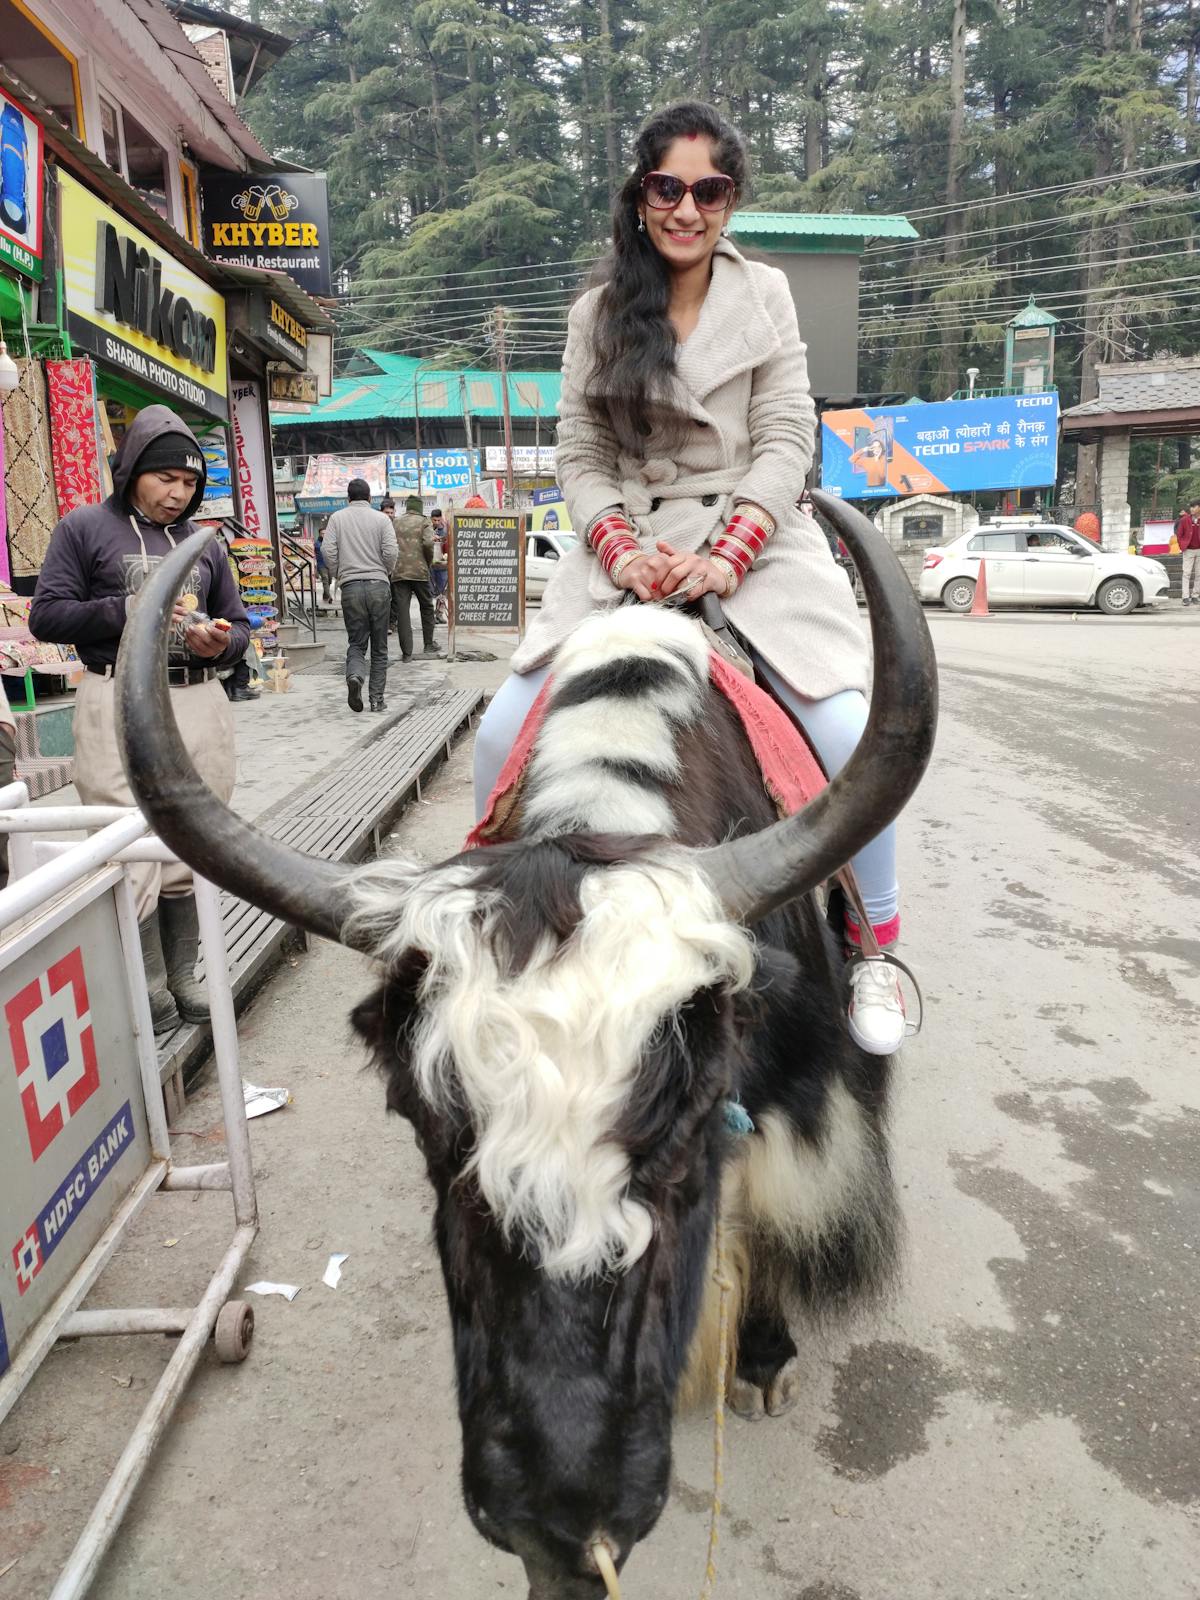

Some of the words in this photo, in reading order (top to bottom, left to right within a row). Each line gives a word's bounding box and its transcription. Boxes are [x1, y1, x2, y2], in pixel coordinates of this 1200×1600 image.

[212, 223, 319, 247] KHYBER
[257, 255, 320, 269] Restaurant
[95, 220, 217, 375] Nikon
[271, 300, 307, 349] KHYBER
[106, 338, 148, 377] SHARMA
[149, 366, 178, 391] PHOTO
[178, 377, 206, 406] STUDIO
[1016, 396, 1053, 408] TECNO
[956, 423, 992, 439] त्योहारों
[996, 421, 1011, 435] की
[913, 442, 960, 457] TECNO
[964, 439, 1011, 453] SPARK
[1014, 434, 1026, 448] के
[1031, 434, 1049, 447] संग
[233, 403, 261, 535] STAURANT
[457, 518, 483, 529] TODAY
[485, 519, 516, 529] SPECIAL
[457, 531, 477, 539] FISH
[479, 531, 506, 539] CURRY
[457, 540, 474, 548] DAL
[477, 540, 508, 548] YELLOW
[457, 549, 476, 557] VEG.
[469, 585, 489, 593] STEAK
[489, 585, 517, 593] SIZZLER
[477, 594, 500, 602] PIZZA
[459, 603, 490, 611] CHICKEN
[490, 603, 513, 611] PIZZA
[459, 612, 486, 621] CHEESE
[488, 612, 512, 621] PIZZA
[43, 1171, 86, 1244] HDFC
[87, 1115, 129, 1182] BANK
